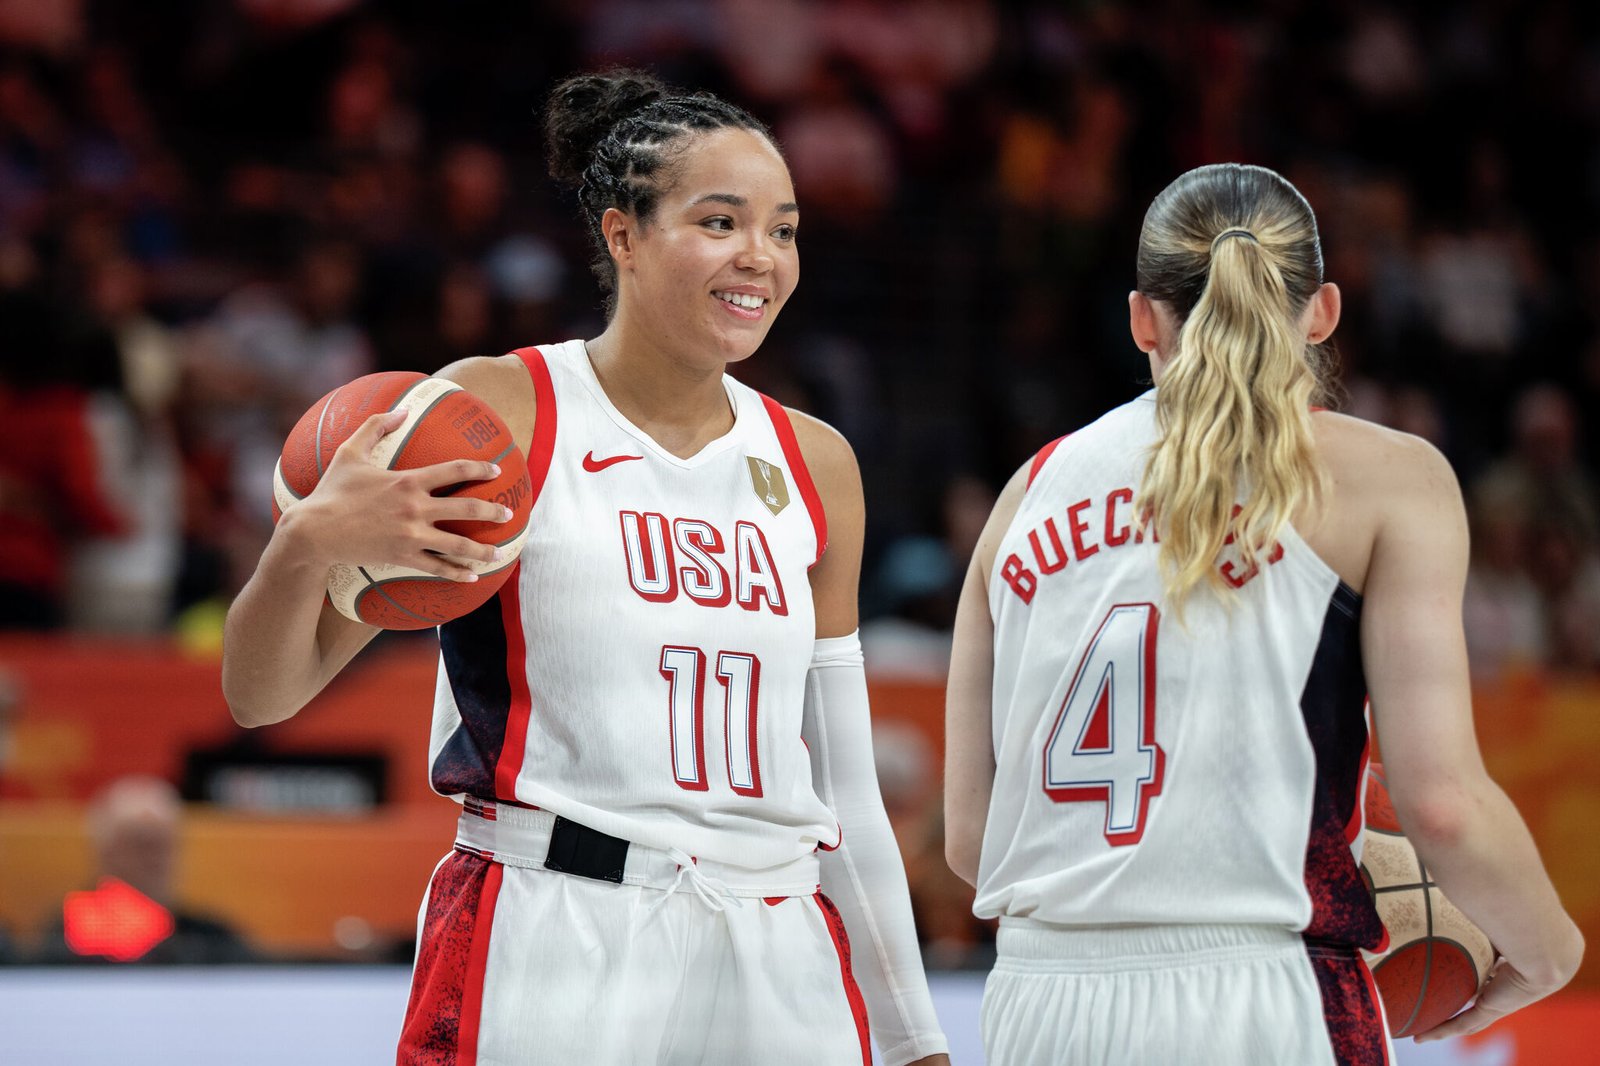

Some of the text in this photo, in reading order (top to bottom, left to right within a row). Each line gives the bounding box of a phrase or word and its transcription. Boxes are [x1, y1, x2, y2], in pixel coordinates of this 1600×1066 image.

[462, 414, 500, 450] FIBA
[488, 471, 531, 511] olte
[1000, 487, 1285, 605] BUECS
[619, 510, 789, 616] USA
[659, 644, 763, 798] 11
[1042, 602, 1166, 847] 4
